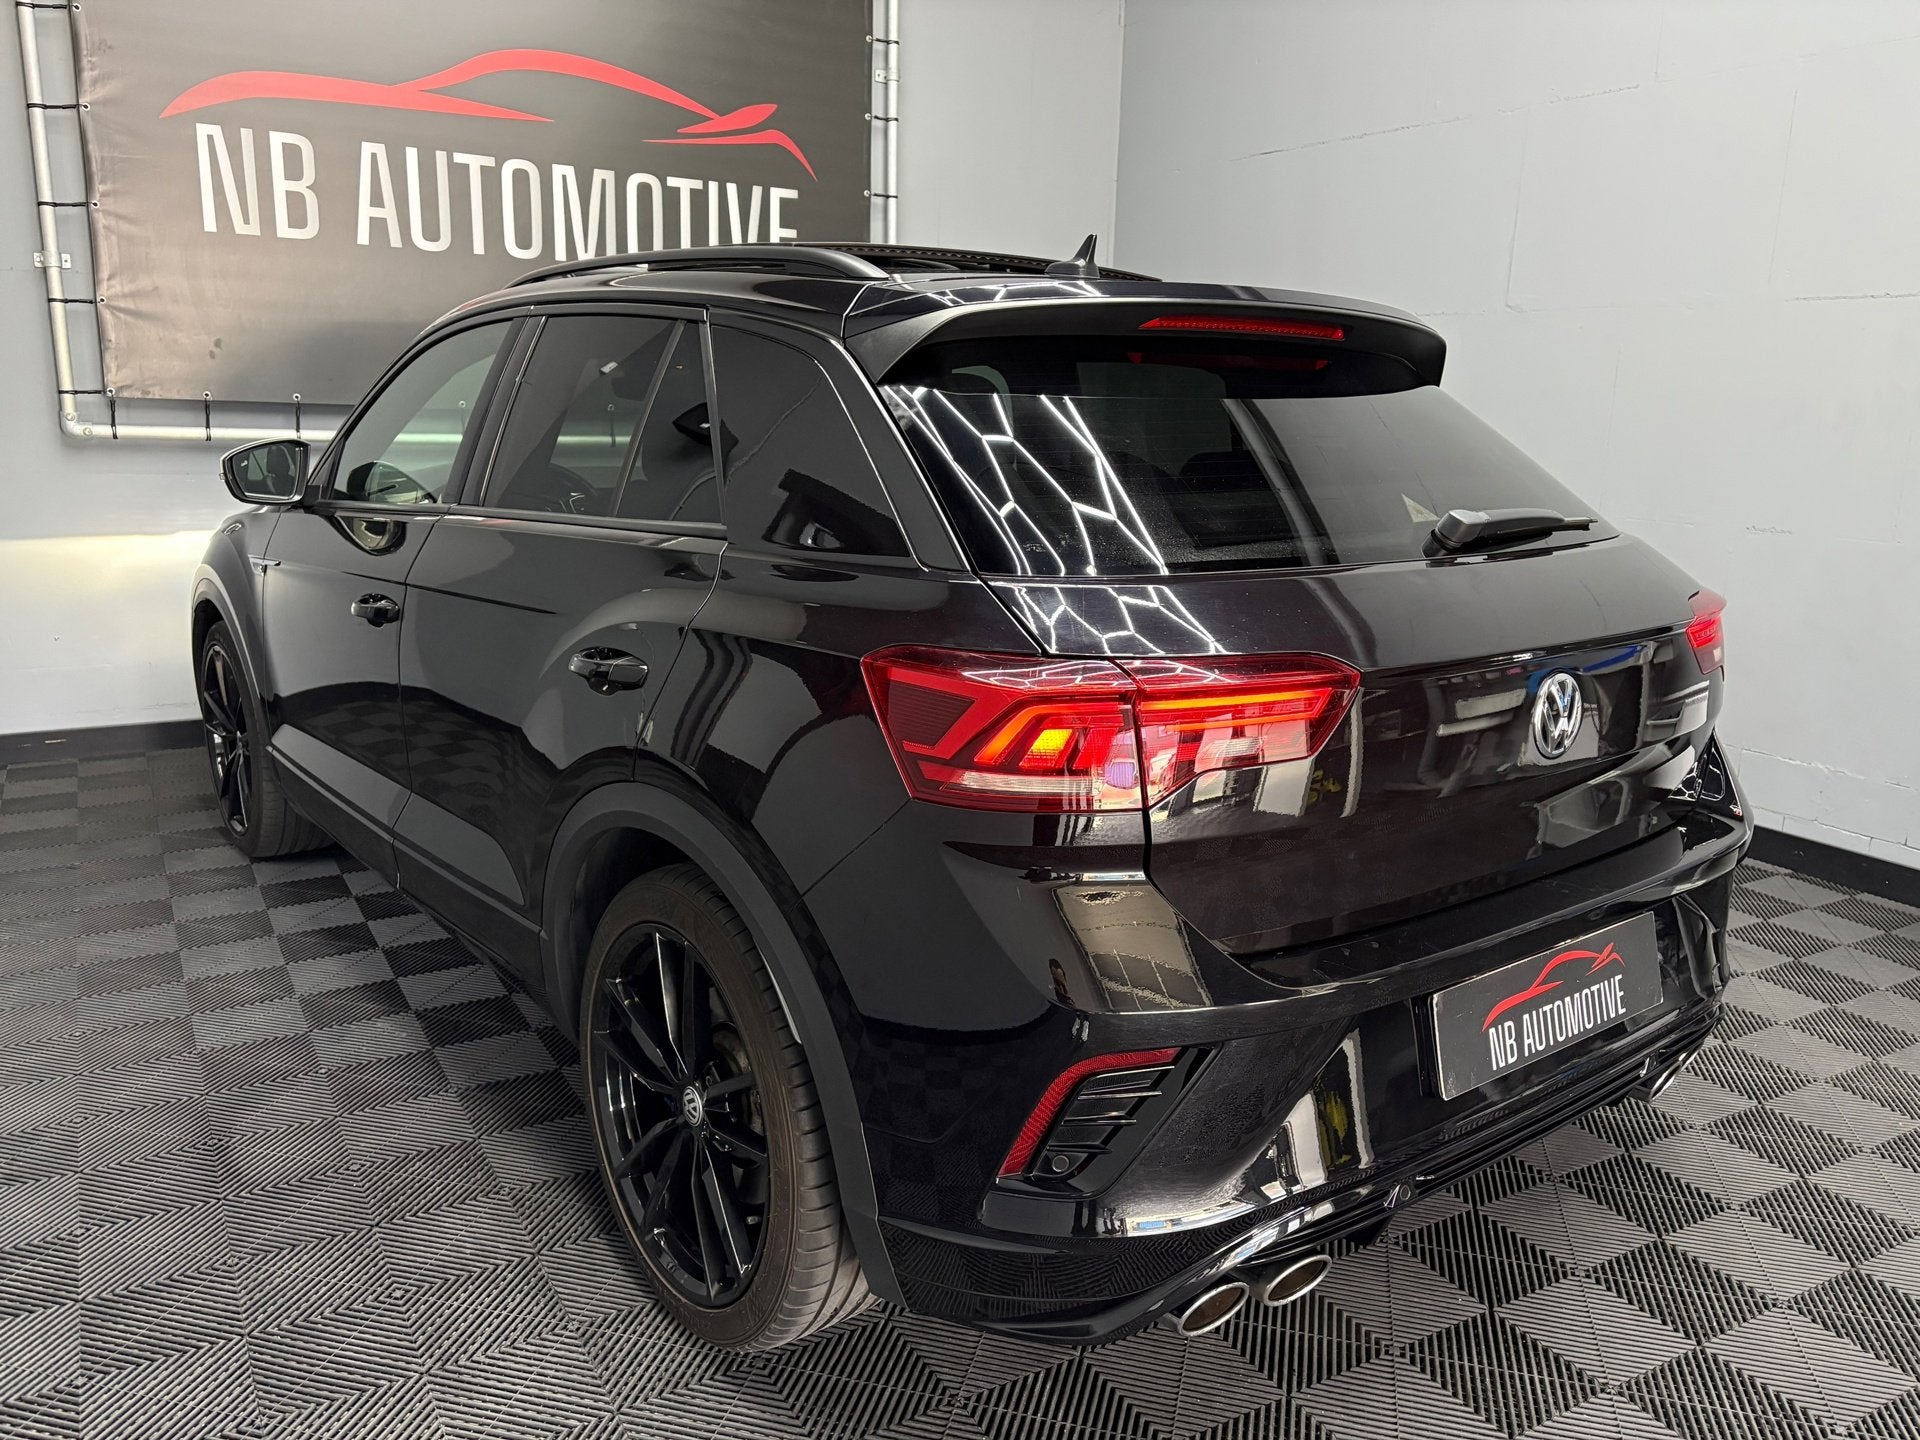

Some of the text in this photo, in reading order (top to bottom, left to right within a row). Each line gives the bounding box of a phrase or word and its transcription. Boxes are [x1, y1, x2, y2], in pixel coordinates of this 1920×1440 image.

[195, 122, 800, 262] NB AUTOMOTIVE
[1532, 672, 1583, 758] VW
[1488, 974, 1627, 1071] NB AUTOMOTIVE
